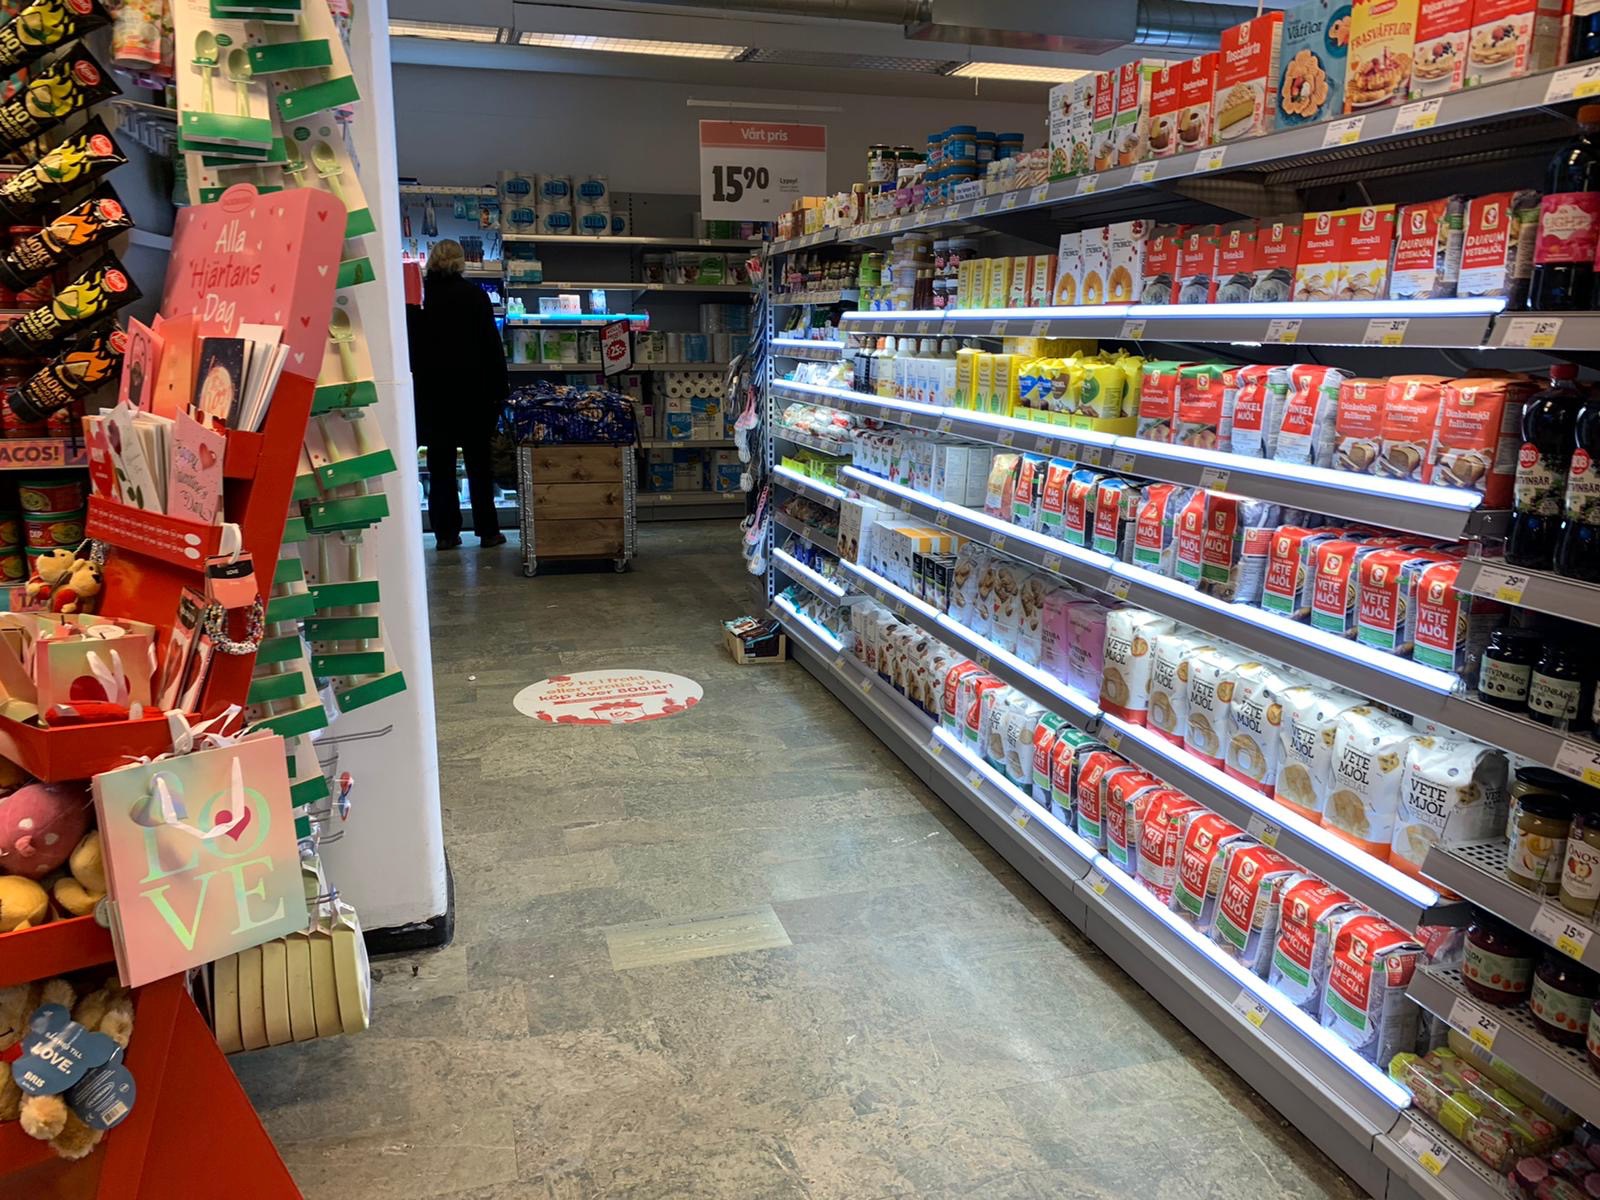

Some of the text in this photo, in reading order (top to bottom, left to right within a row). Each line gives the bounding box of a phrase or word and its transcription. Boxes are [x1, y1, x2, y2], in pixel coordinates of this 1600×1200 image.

[8, 102, 37, 131] HOT
[741, 127, 789, 143] Vårt pris
[214, 219, 247, 254] Alla
[1466, 231, 1505, 246] DURUM
[190, 254, 262, 299] Hjärtans
[36, 306, 61, 330] HOT
[203, 293, 237, 332] Dag
[40, 366, 75, 403] SMOKEY
[1138, 526, 1159, 539] MJÖL
[1180, 538, 1200, 554] MJÖL
[1205, 539, 1229, 554] MJÖL
[1317, 578, 1341, 592] VETE
[1316, 591, 1341, 607] MJÖL
[1361, 591, 1390, 608] VETE
[1361, 605, 1390, 622] MJÖL
[1419, 608, 1449, 624] VETE
[1418, 622, 1449, 642] MJÖL
[1107, 637, 1132, 654] VETE
[539, 692, 571, 703] köp
[576, 688, 614, 697] över
[618, 686, 650, 694] 800
[1192, 678, 1215, 698] VETE
[1190, 692, 1214, 712] MJÖL
[1237, 712, 1262, 734] MJÖL
[1291, 725, 1315, 744] VETE
[1289, 738, 1315, 760] MJÖL
[1343, 747, 1371, 771] VETE
[1338, 761, 1370, 785] MJÖL
[1410, 778, 1448, 803] VETE
[1409, 794, 1447, 818] MJÖL
[1144, 825, 1165, 845] VETE
[1184, 851, 1206, 873] VETE
[1568, 842, 1599, 865] ÖNOS
[1182, 867, 1203, 888] MJÖL
[140, 856, 286, 952] VE
[1228, 885, 1251, 907] VETE
[1223, 897, 1248, 921] MJÖL
[1333, 969, 1365, 997] SPECIAL
[30, 1041, 74, 1076] LOVE.
[71, 1048, 84, 1060] TILL
